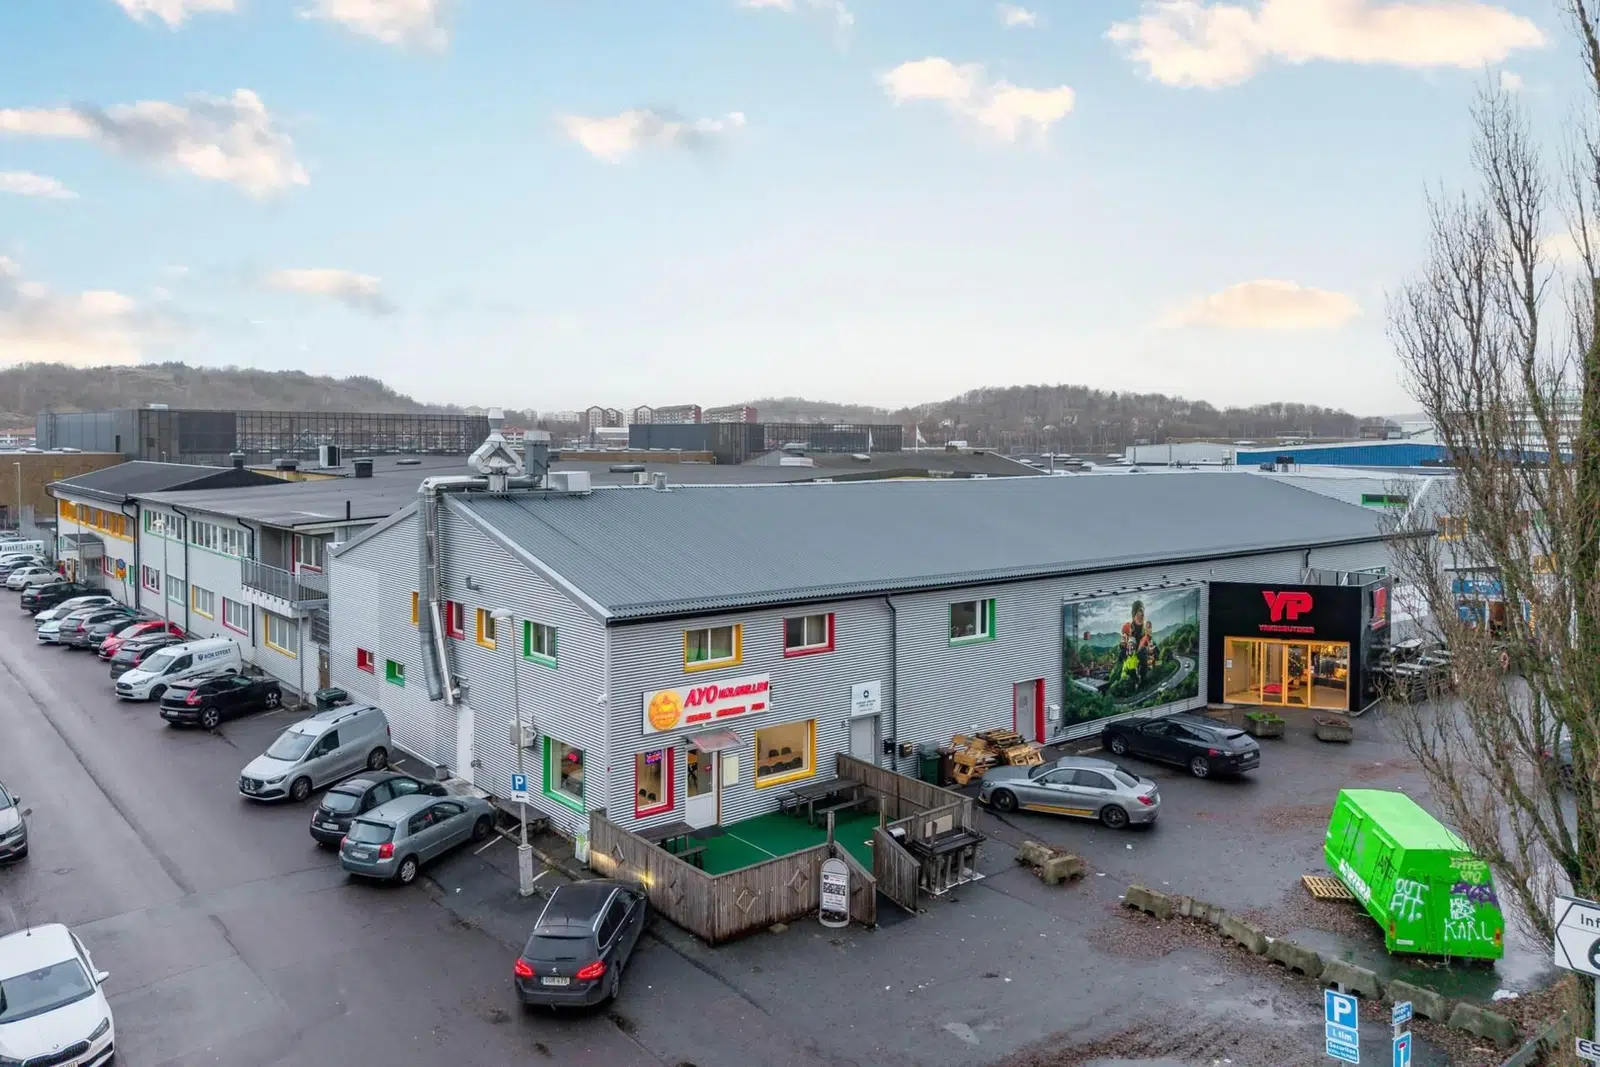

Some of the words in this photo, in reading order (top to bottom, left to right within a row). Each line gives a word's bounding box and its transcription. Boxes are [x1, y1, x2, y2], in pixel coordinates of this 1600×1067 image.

[1262, 591, 1313, 621] YP
[684, 685, 718, 707] AYO
[514, 775, 524, 790] P
[1444, 918, 1495, 944] KARL
[1333, 996, 1352, 1022] P
